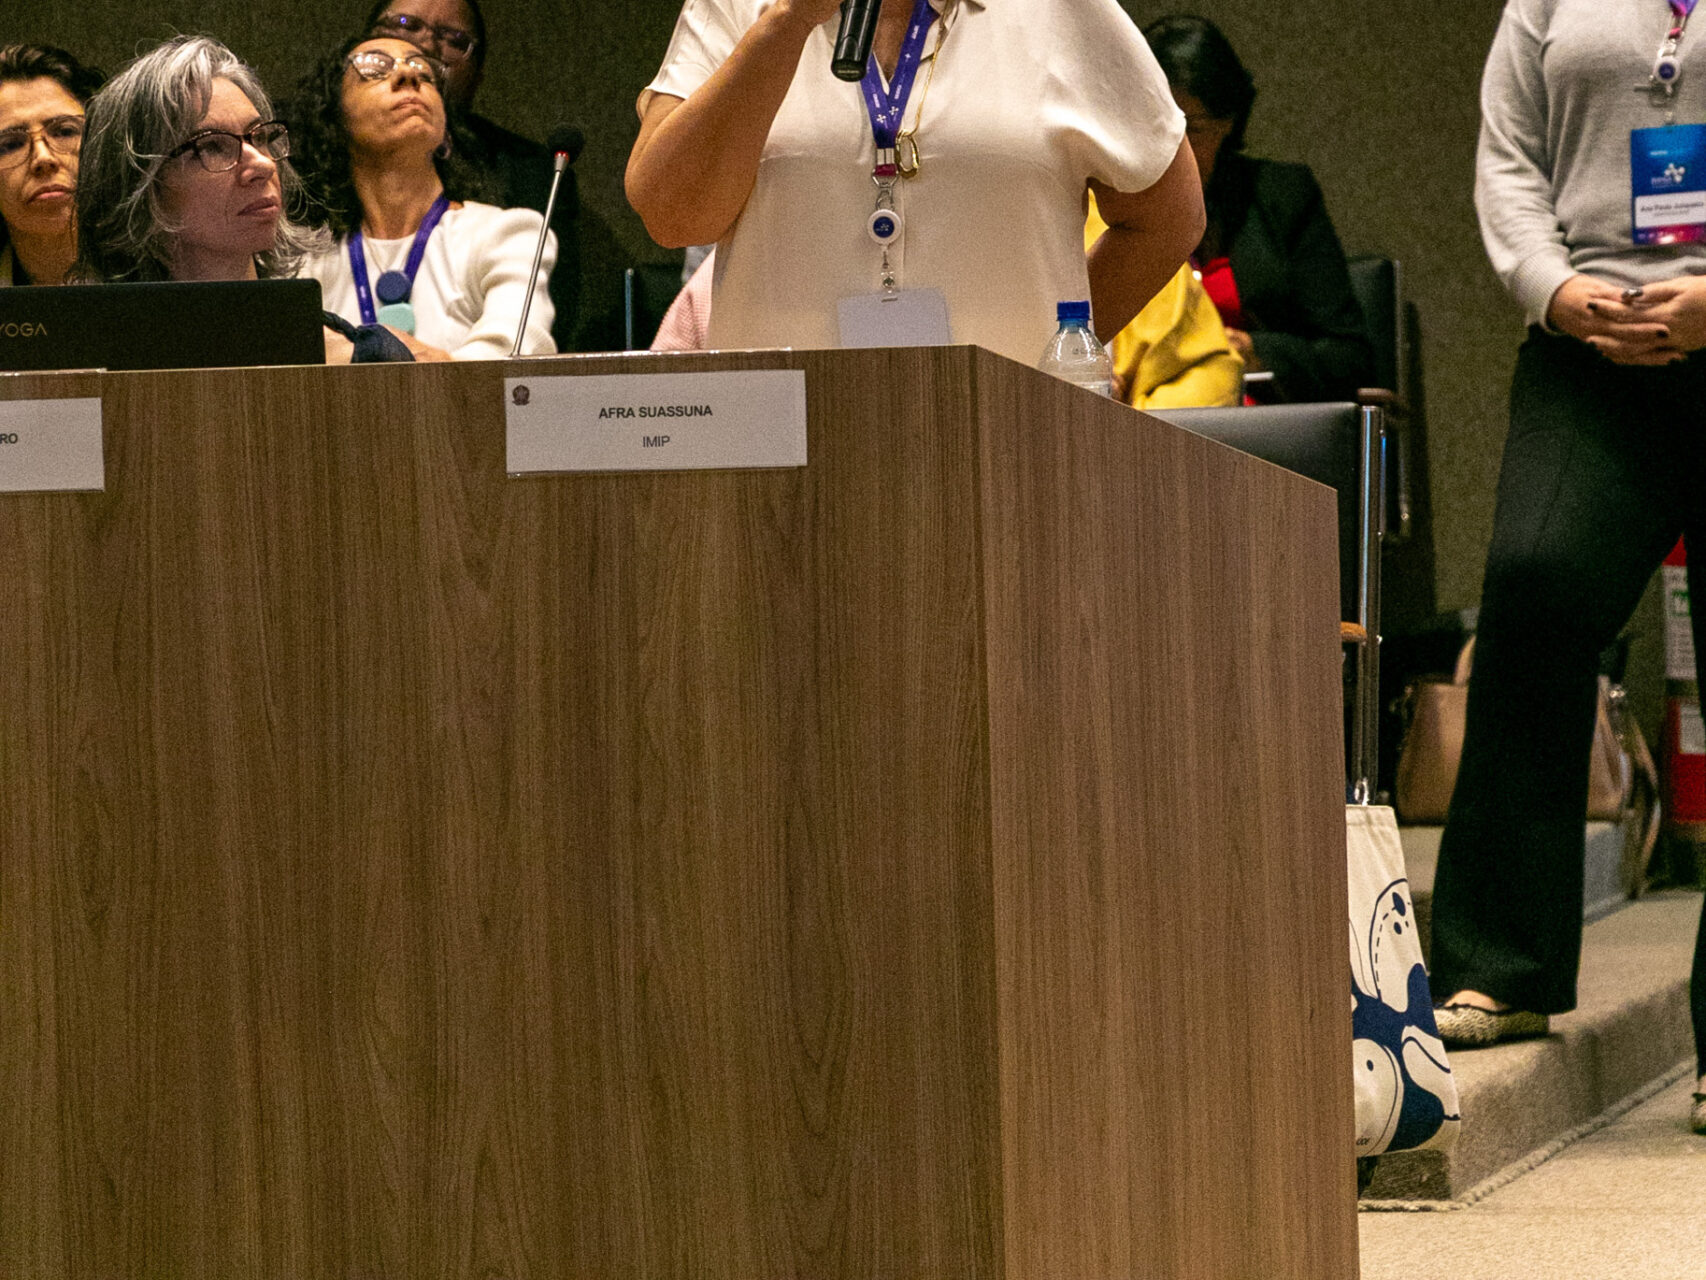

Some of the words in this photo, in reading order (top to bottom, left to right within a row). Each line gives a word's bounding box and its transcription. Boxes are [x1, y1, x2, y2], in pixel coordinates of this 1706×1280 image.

[599, 407, 635, 419] AFRA
[639, 405, 713, 418] SUASSUNA
[643, 435, 671, 448] IMIP
